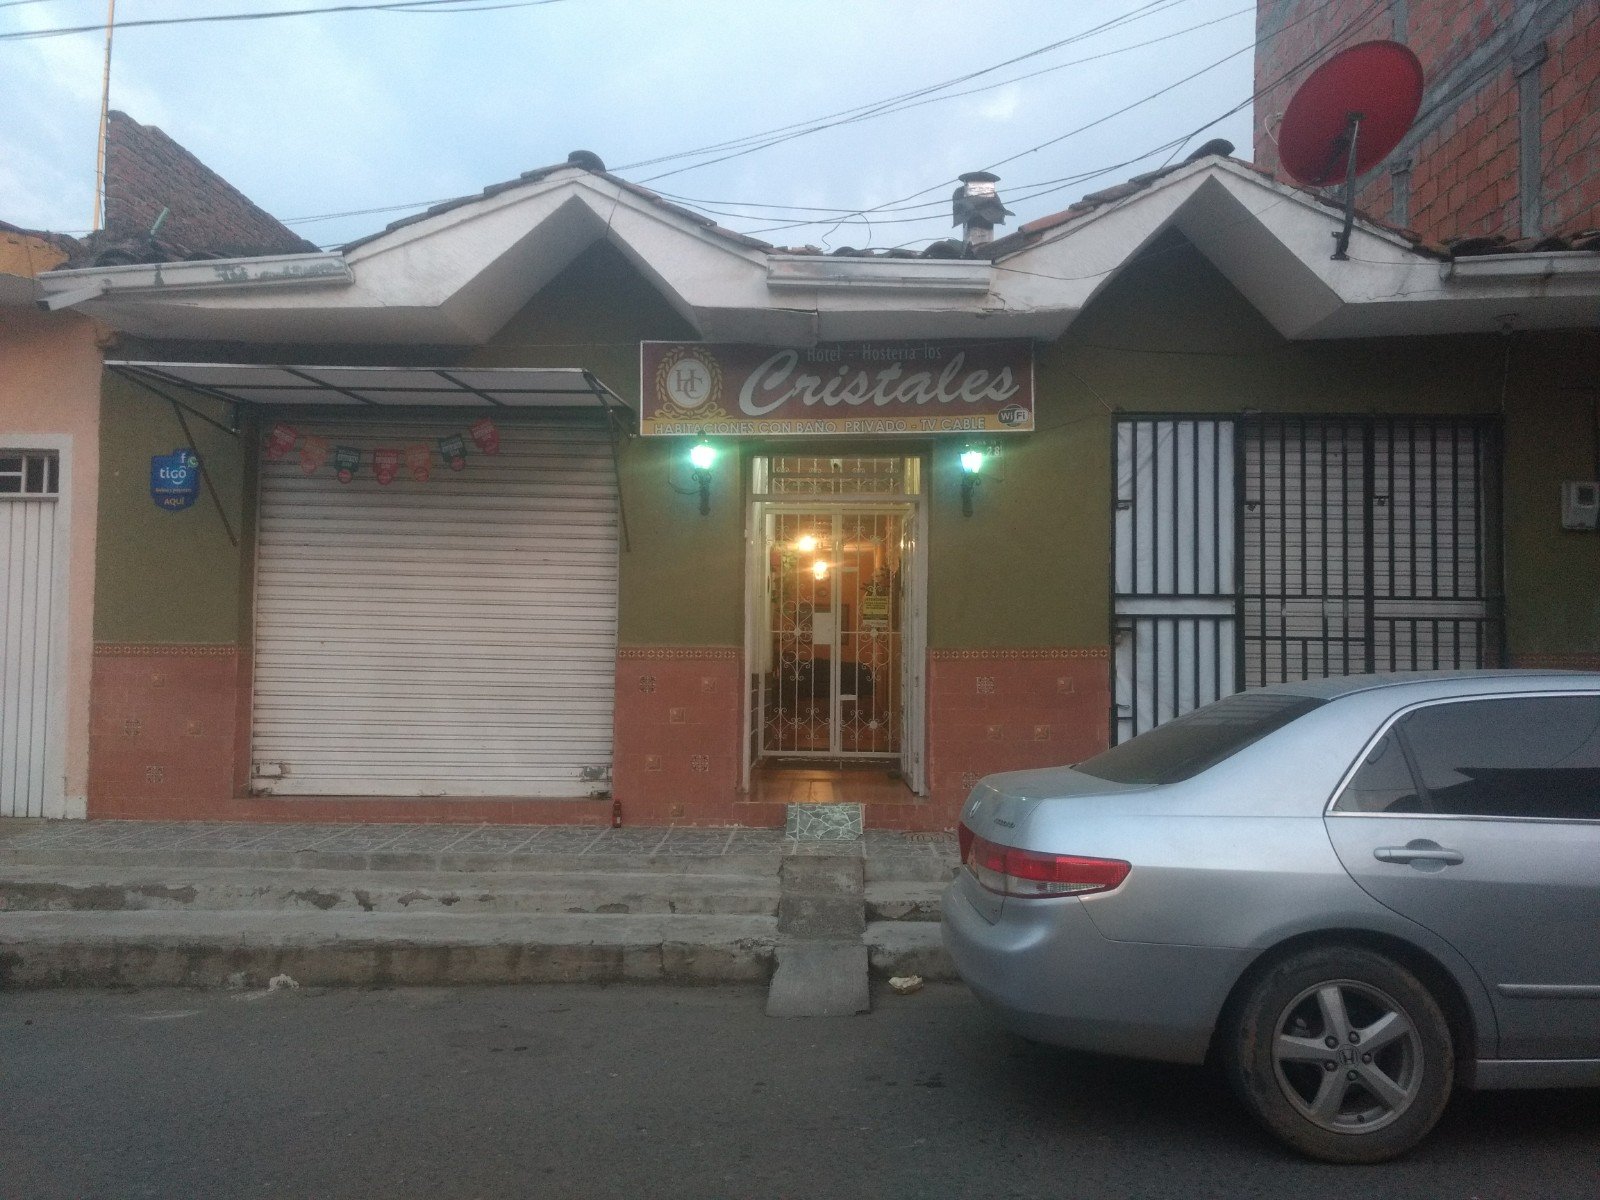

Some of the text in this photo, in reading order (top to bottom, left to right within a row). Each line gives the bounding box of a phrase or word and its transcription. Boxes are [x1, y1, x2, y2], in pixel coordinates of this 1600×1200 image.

[807, 345, 840, 362] Hotel
[924, 342, 943, 360] los
[739, 349, 1020, 416] Cristales
[654, 422, 754, 434] HABITACIONES
[759, 422, 794, 433] CON
[796, 419, 837, 433] BAÑO
[845, 419, 907, 432] PRIVADO
[920, 418, 937, 431] TV
[941, 417, 986, 430] CABLE
